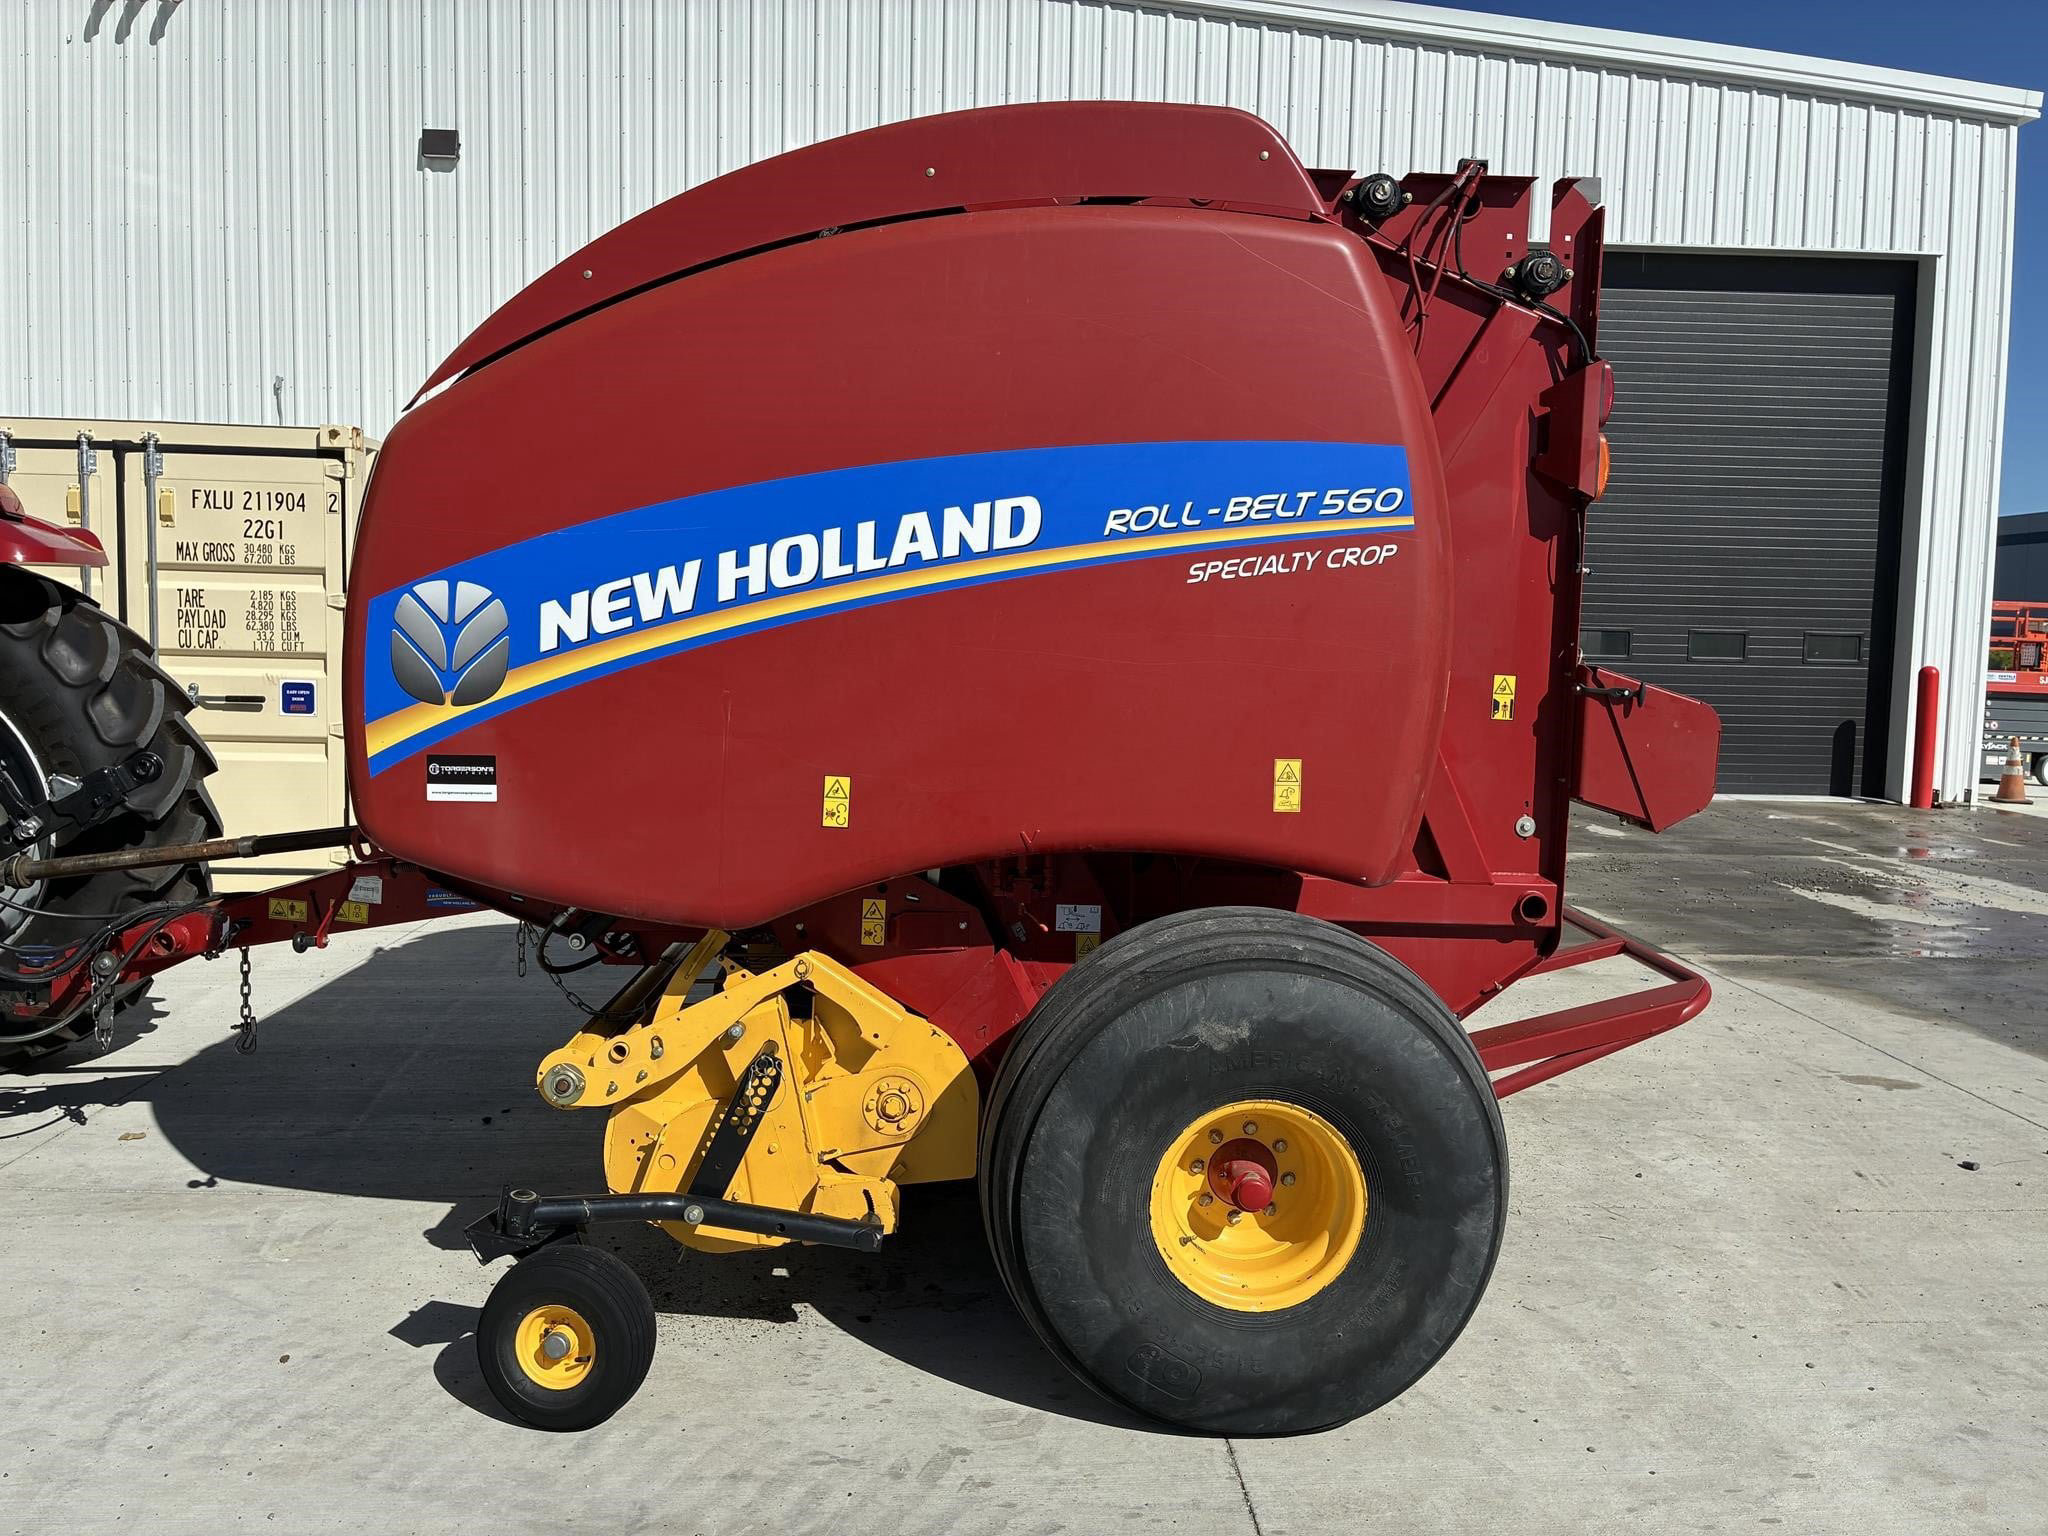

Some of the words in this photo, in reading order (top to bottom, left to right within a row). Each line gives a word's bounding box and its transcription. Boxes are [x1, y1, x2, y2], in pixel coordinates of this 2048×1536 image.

[192, 489, 233, 510] FXLU
[243, 491, 306, 512] 211904
[328, 493, 338, 513] 2
[1319, 487, 1404, 516] 560
[243, 519, 283, 539] 22G1
[176, 541, 199, 562] MAX
[203, 542, 235, 562] GROSS
[279, 545, 296, 555] KGS
[244, 553, 273, 564] 67.200
[279, 555, 296, 565] LBS
[1186, 550, 1323, 584] SPECIALTY
[1326, 544, 1398, 569] CROP
[539, 559, 703, 654] NEW
[717, 495, 1043, 603] HOLLAND
[177, 588, 205, 608] TARE
[250, 590, 274, 601] 2.185
[280, 591, 297, 601] KGS
[250, 601, 274, 611] 4.820
[280, 601, 297, 611] LBS
[177, 609, 226, 629] PAYLOAD
[245, 611, 274, 621] 28.295
[280, 611, 297, 621] KGS
[245, 621, 275, 631] 62.380
[280, 621, 297, 631] LBS
[178, 629, 222, 649] CU.CAP.
[256, 631, 275, 641] 33.2
[253, 641, 275, 652] 1.170
